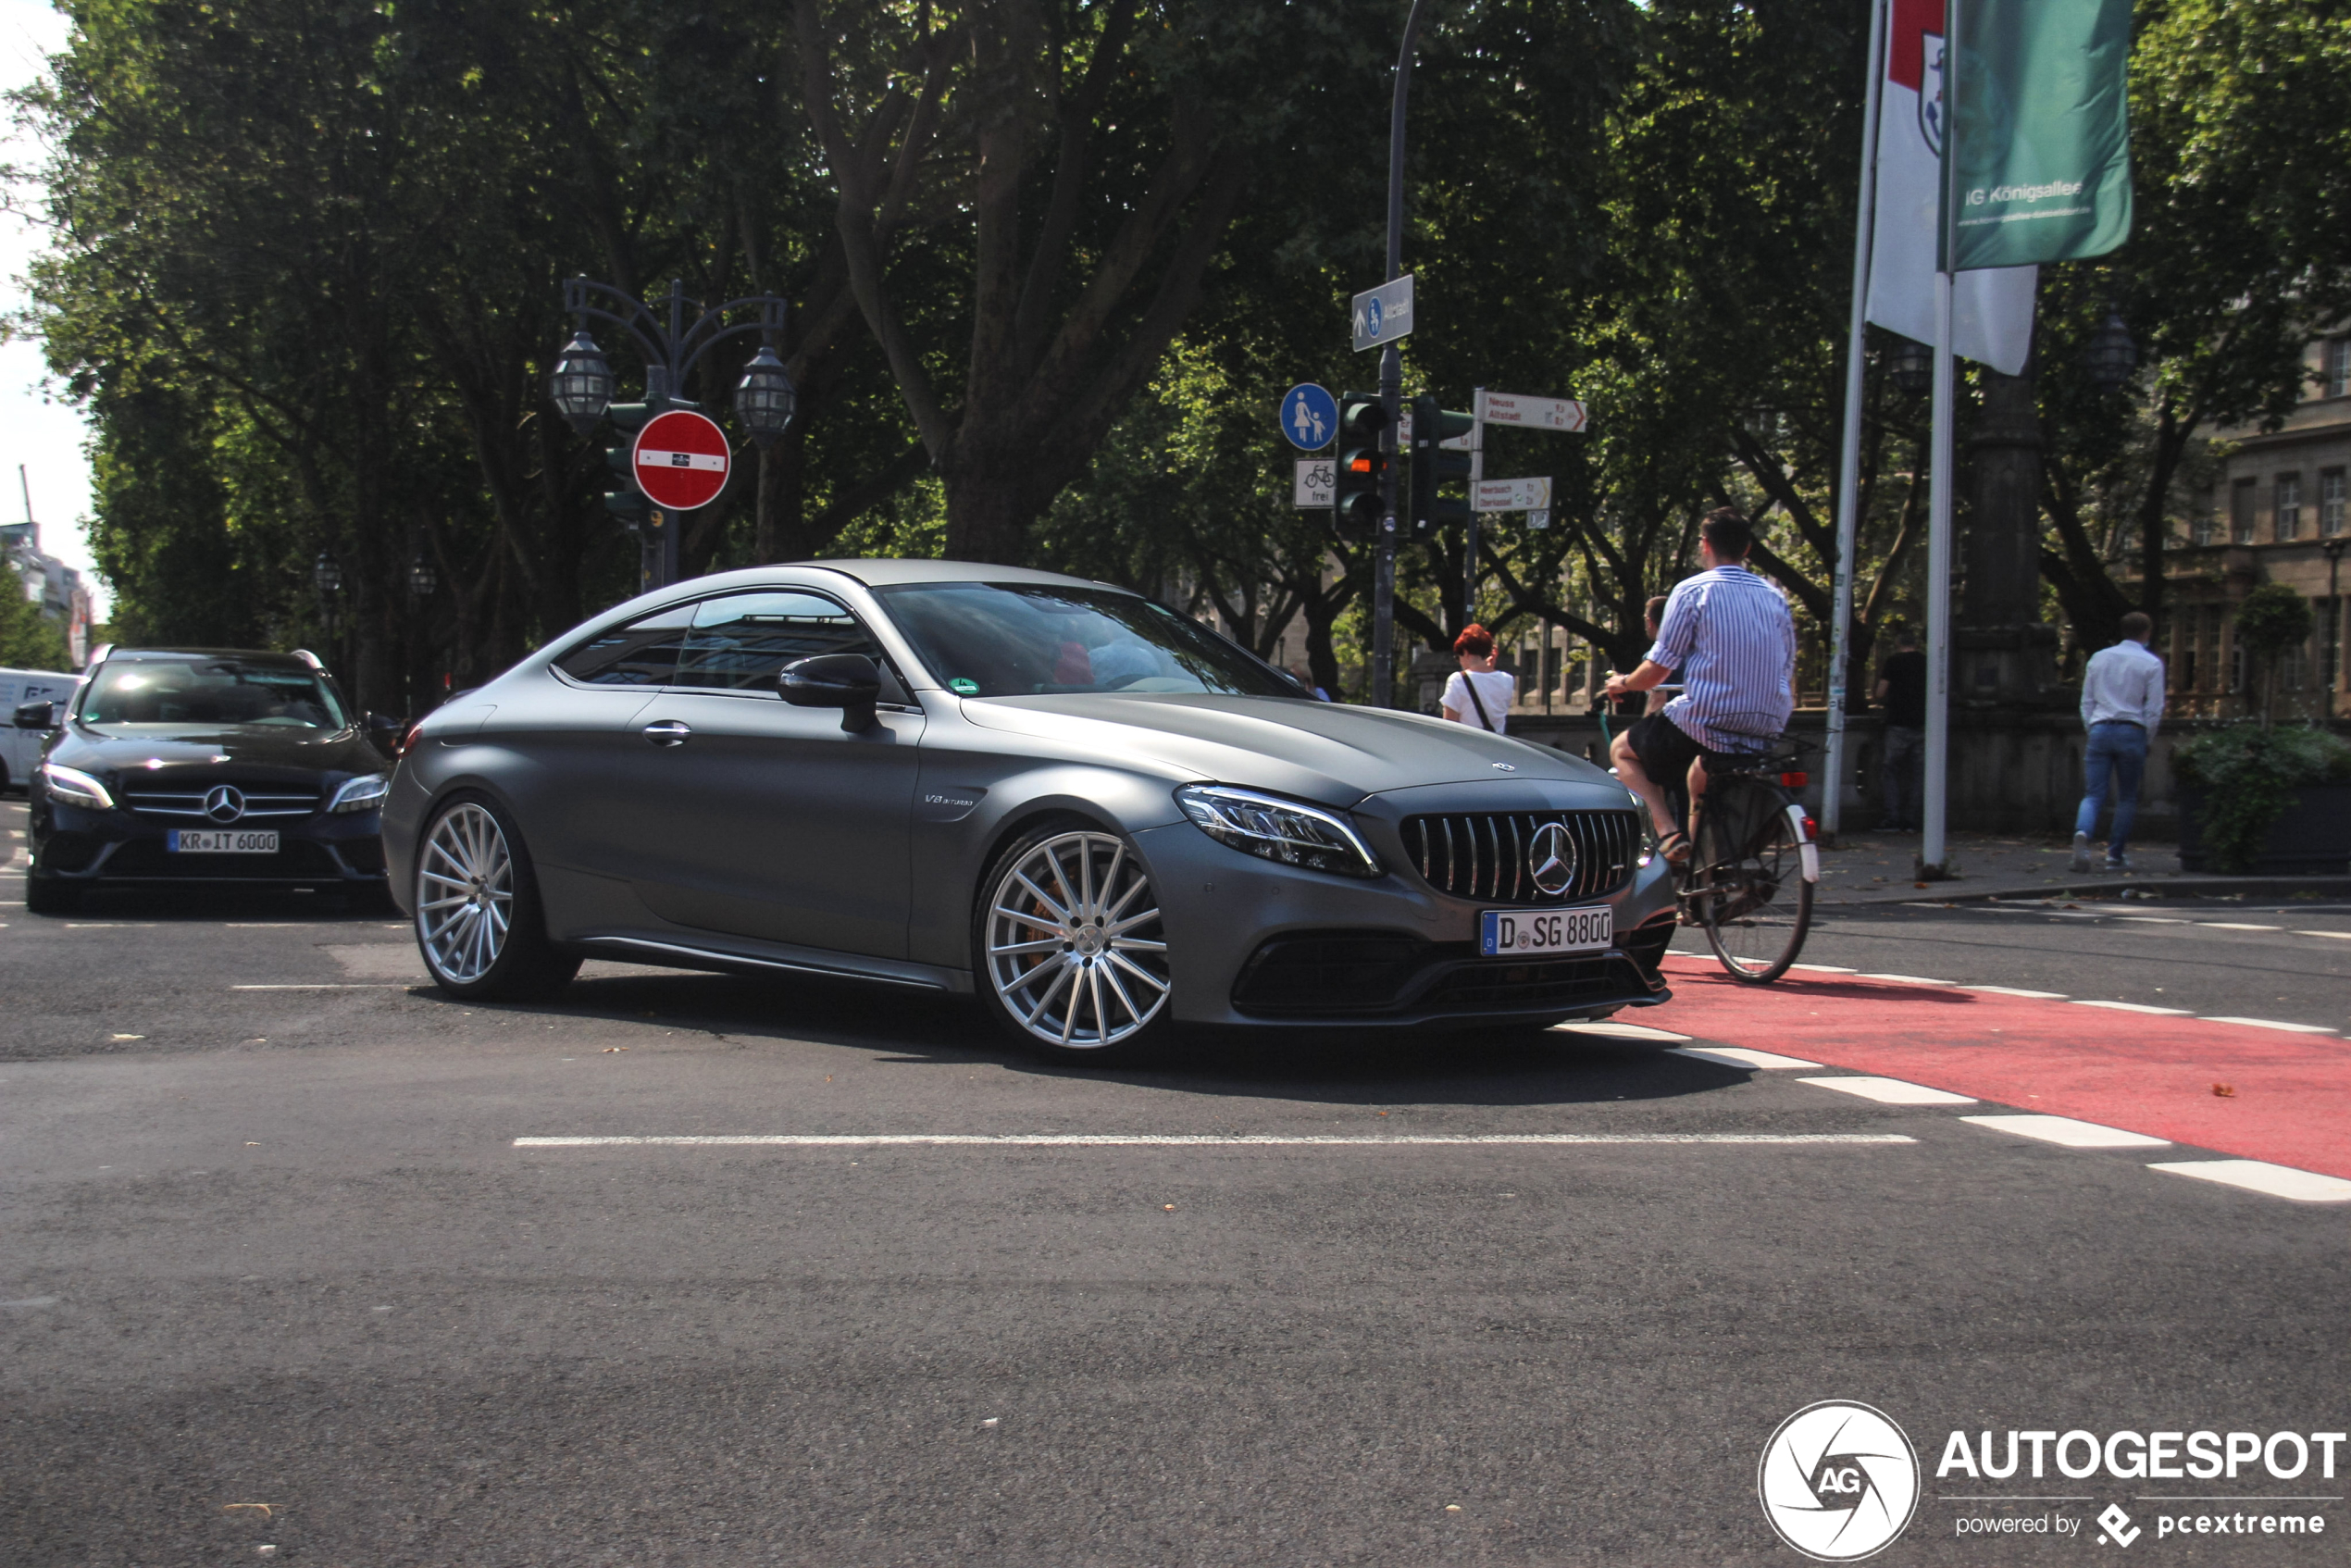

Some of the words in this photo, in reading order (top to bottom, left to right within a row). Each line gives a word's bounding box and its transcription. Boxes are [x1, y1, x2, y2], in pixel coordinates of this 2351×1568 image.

[1965, 189, 1986, 205] IG
[1990, 180, 2083, 204] Königsallee
[1384, 298, 1410, 321] Altstadt
[1488, 397, 1515, 408] Neuss
[1488, 410, 1522, 421] Altstadt
[1312, 491, 1329, 502] frei
[925, 794, 943, 803] V8
[180, 833, 202, 850] KR
[213, 833, 233, 850] IT
[237, 833, 277, 850] 6000
[1499, 917, 1516, 949] D
[1532, 915, 1562, 947] SG
[1566, 912, 1611, 945] 8800
